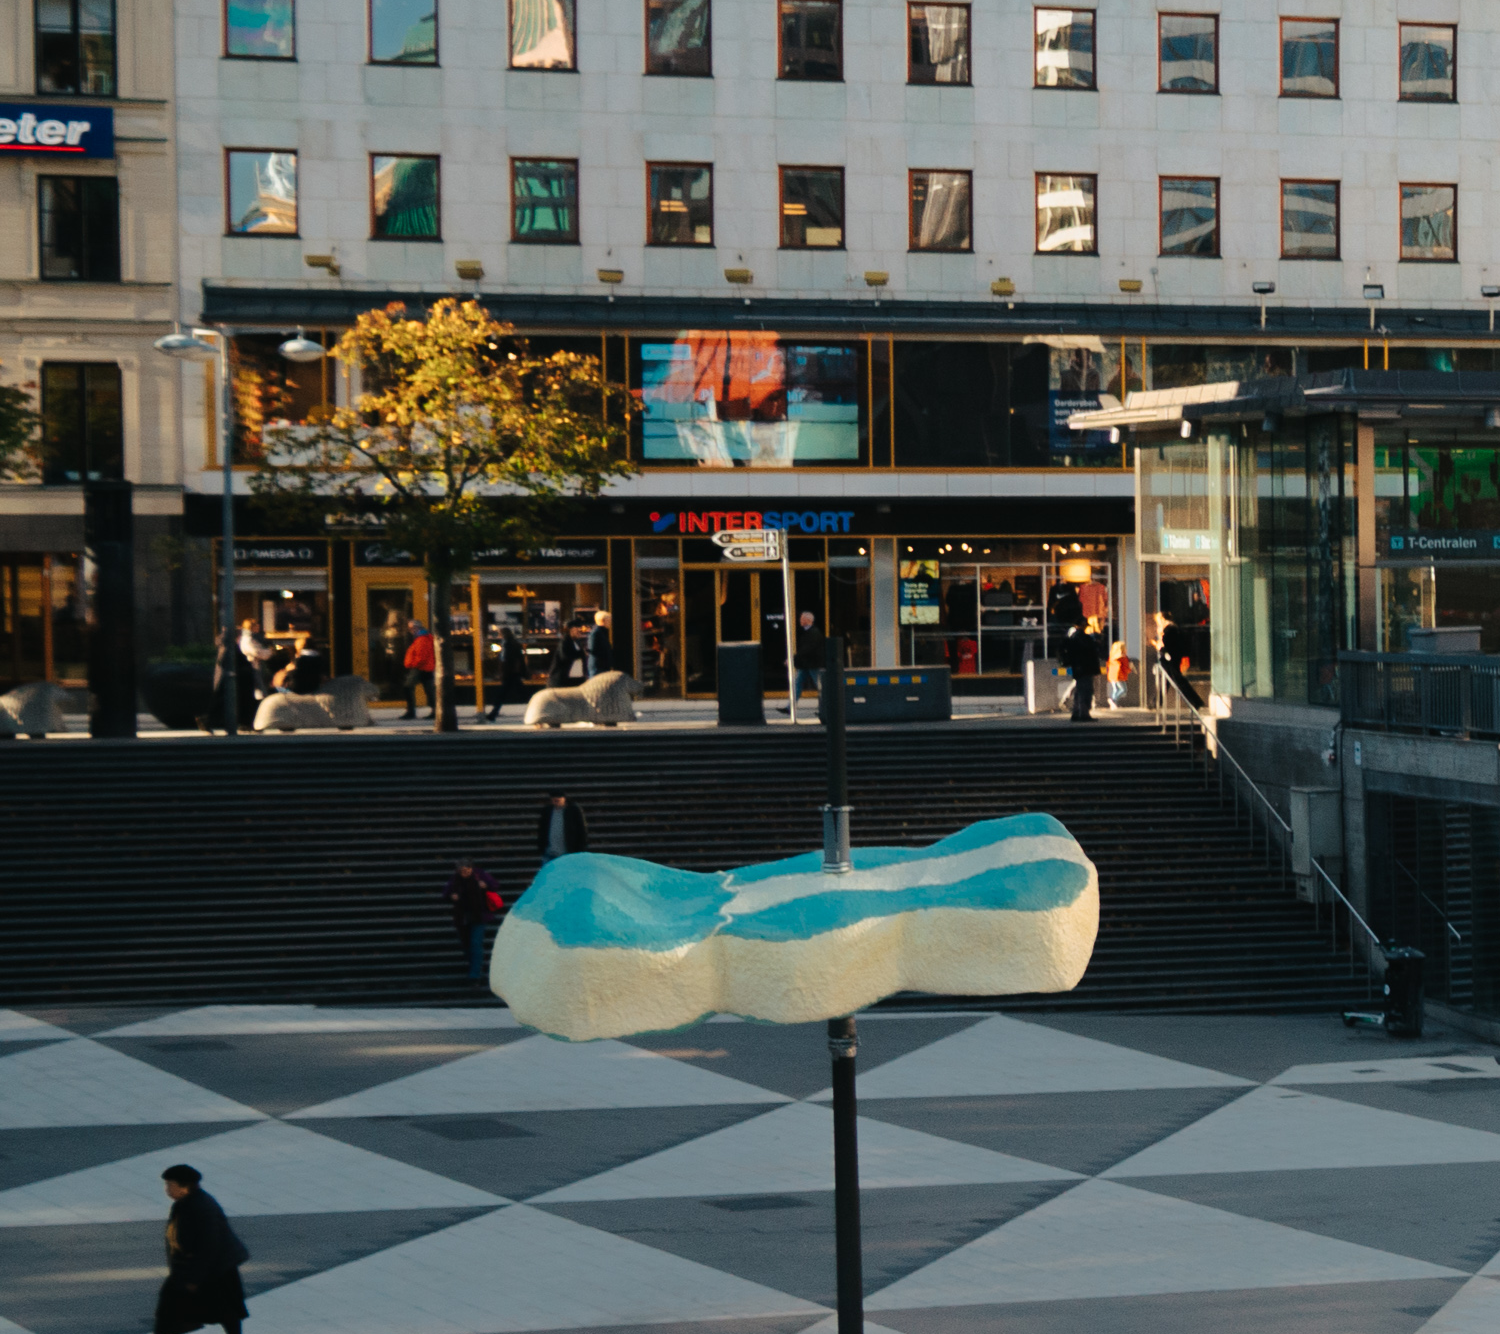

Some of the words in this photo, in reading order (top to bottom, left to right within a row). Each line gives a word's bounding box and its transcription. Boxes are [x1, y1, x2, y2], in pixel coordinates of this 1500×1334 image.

[0, 113, 91, 145] eter
[679, 511, 855, 533] INTERSPORT
[1408, 536, 1477, 549] T-Centralen
